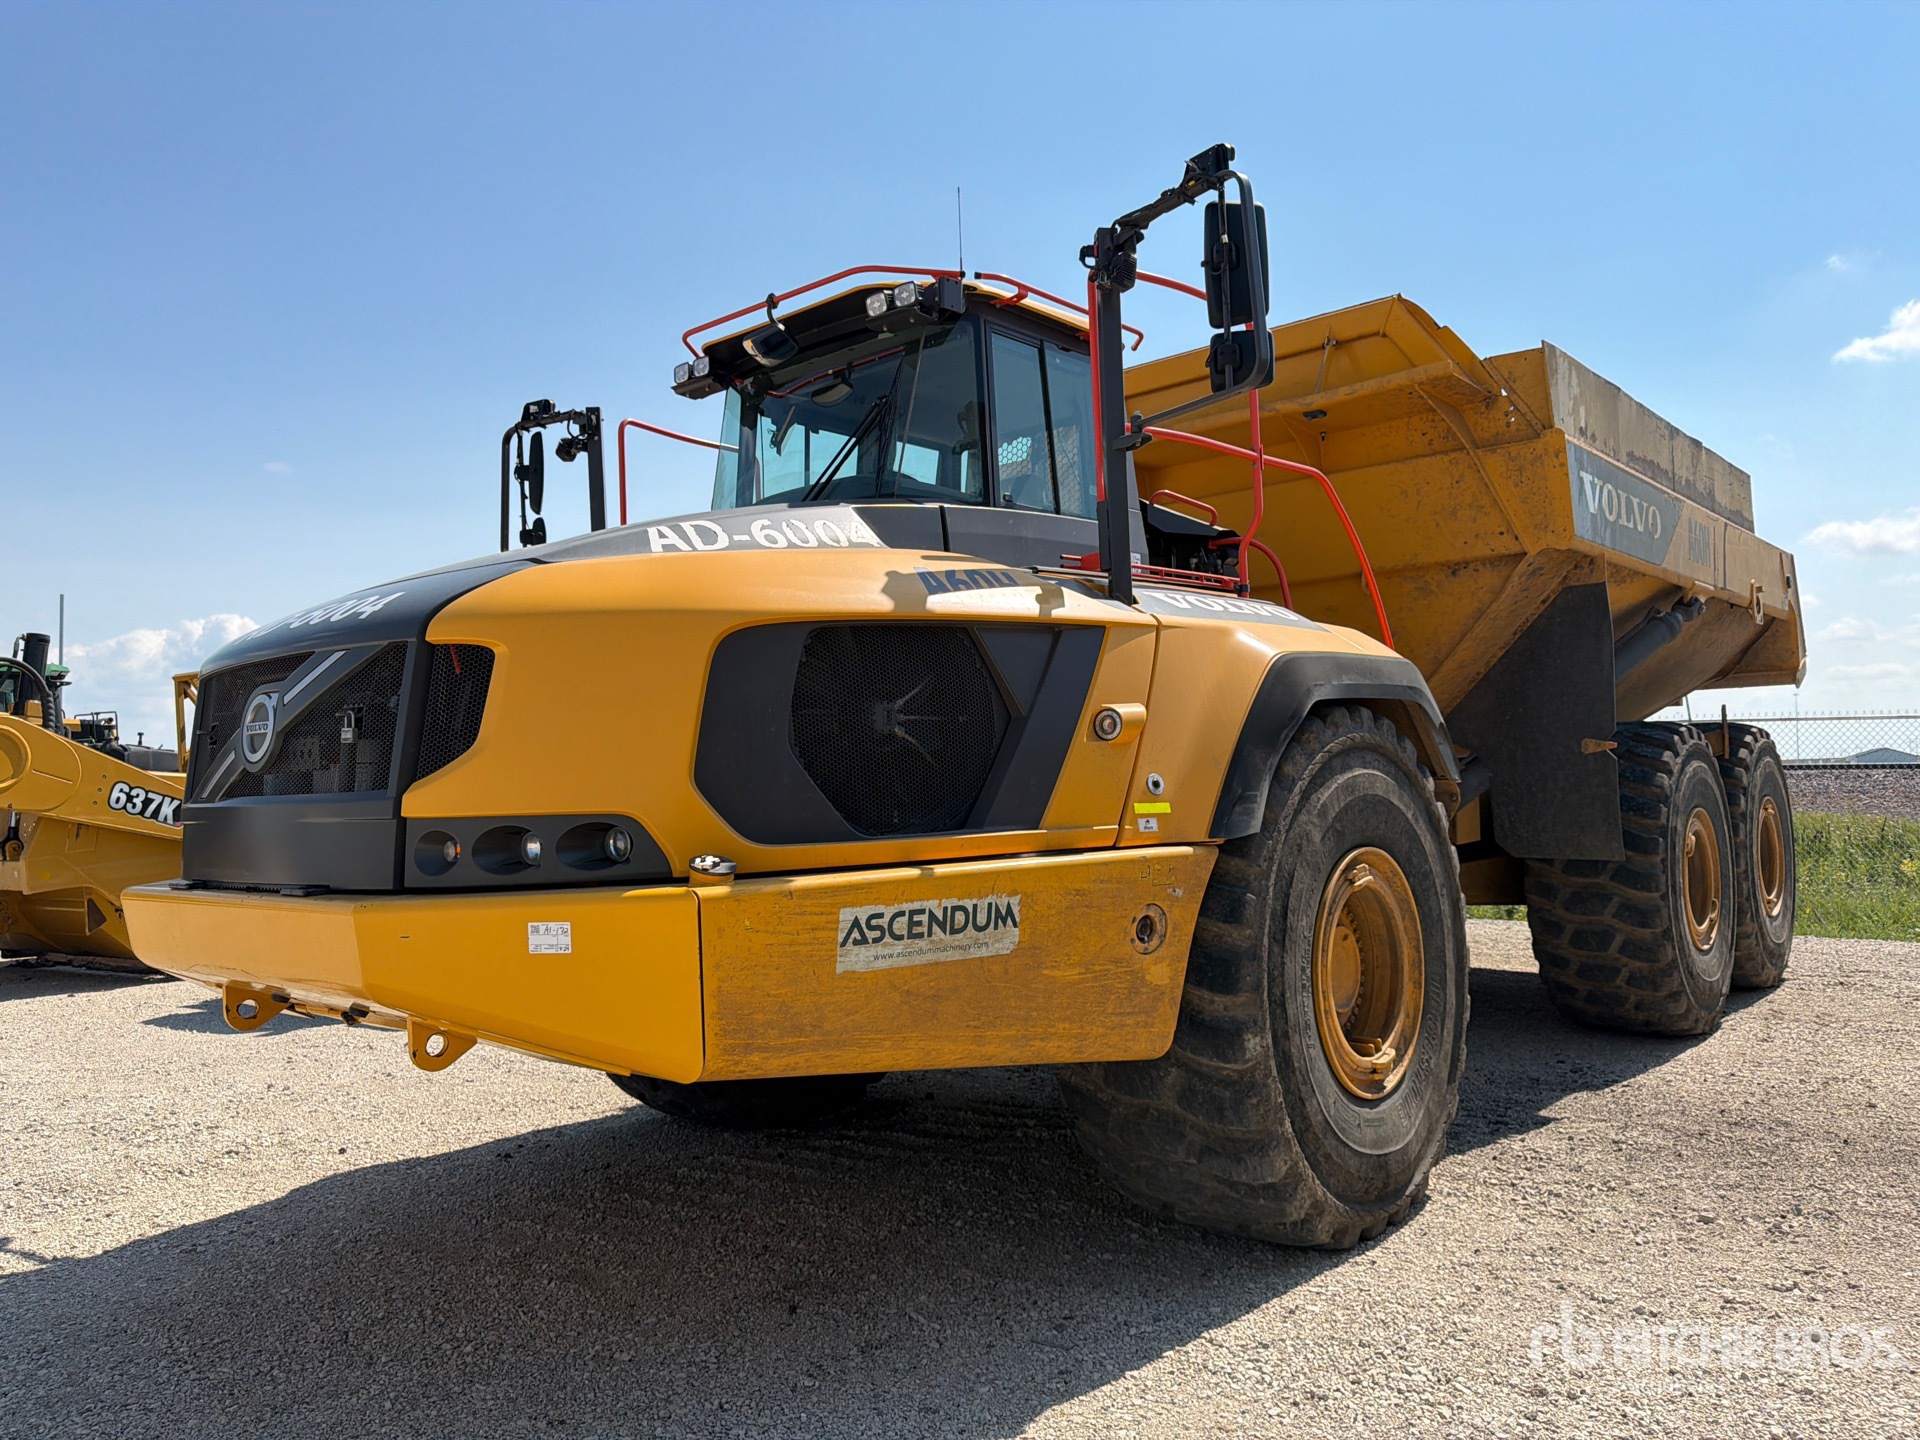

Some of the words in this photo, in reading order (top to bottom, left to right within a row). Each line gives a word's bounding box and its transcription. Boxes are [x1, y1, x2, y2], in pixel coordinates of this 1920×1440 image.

[1580, 471, 1661, 539] VOLVO
[647, 519, 880, 552] AD-6004
[1143, 591, 1299, 621] VOLVO
[246, 722, 268, 733] VOLVO
[109, 782, 181, 825] 637K
[839, 900, 1018, 947] ASCENDUM
[873, 941, 989, 961] www.ascendummachinery.com
